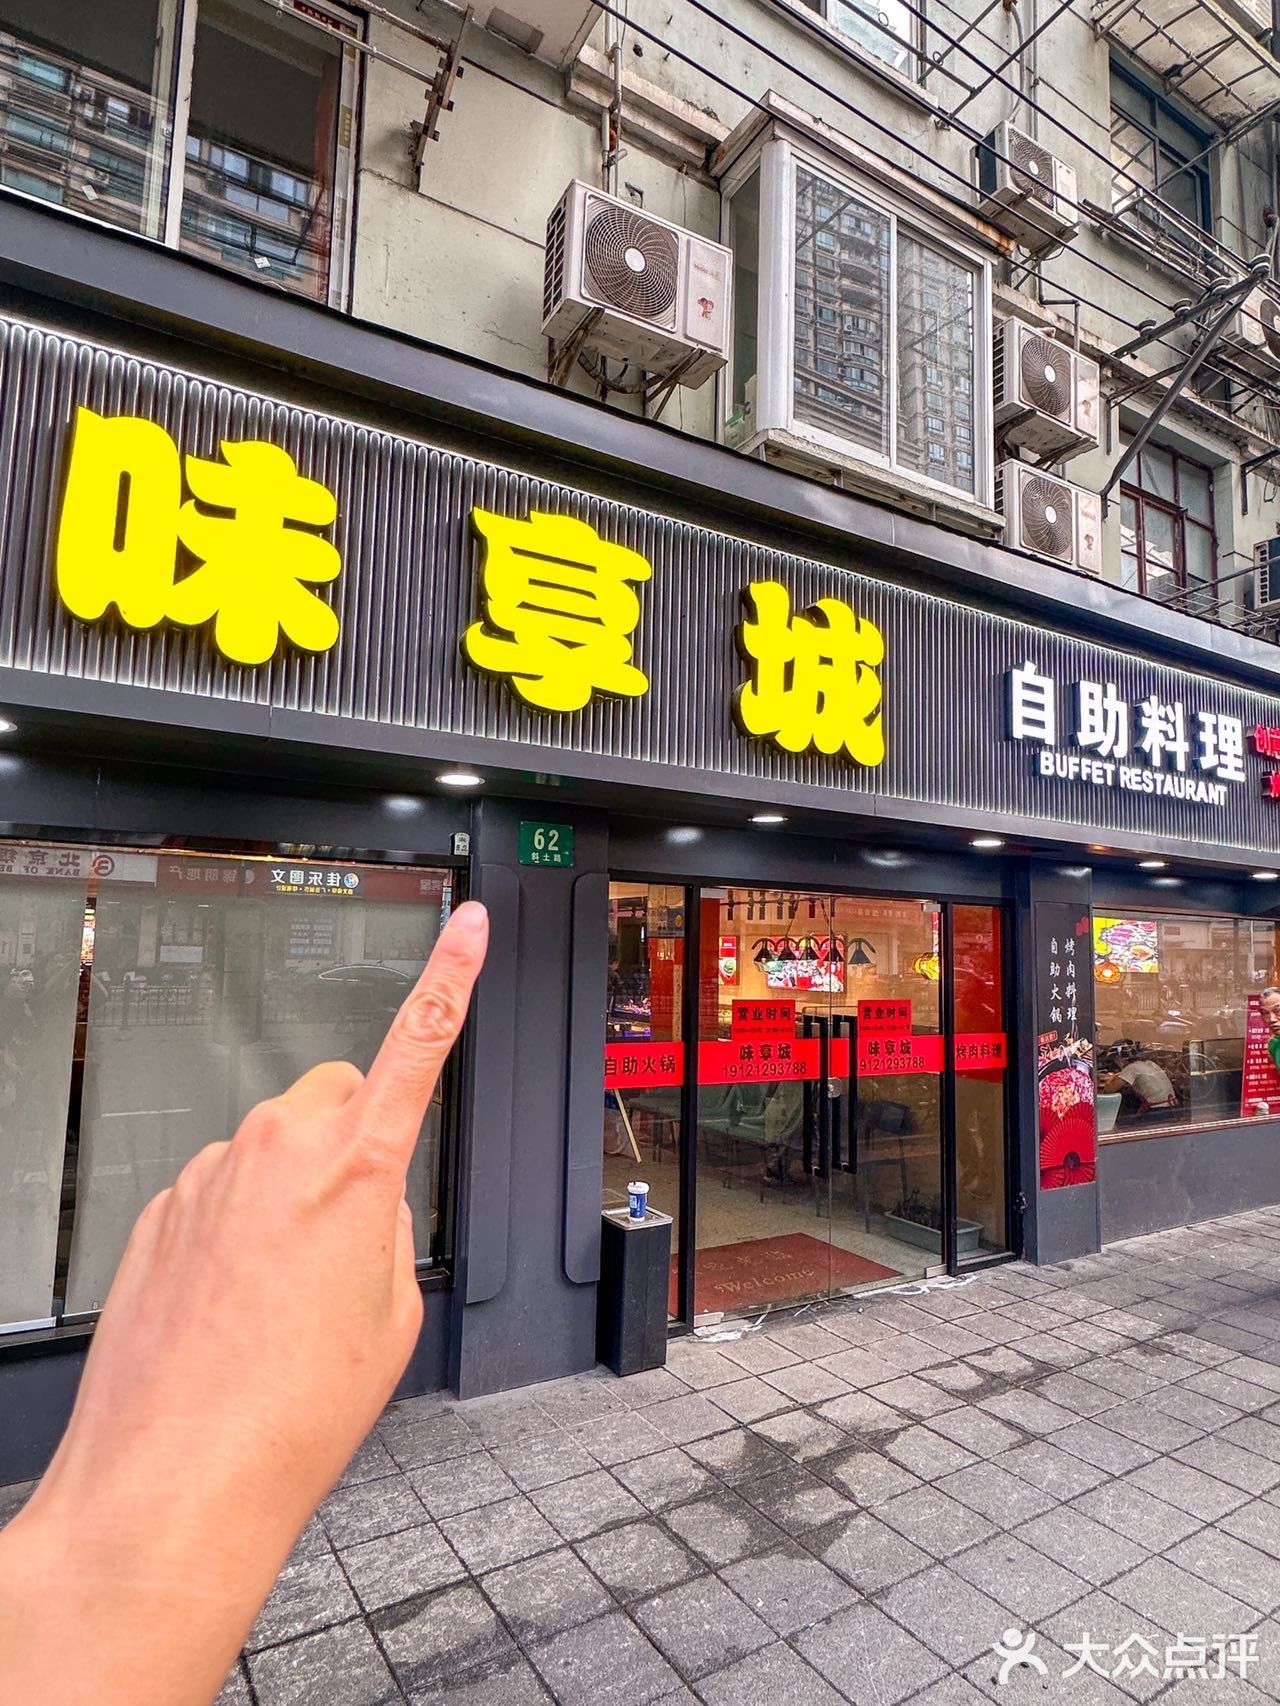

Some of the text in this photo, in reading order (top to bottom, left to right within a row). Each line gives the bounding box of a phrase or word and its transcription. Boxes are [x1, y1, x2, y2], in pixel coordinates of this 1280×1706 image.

[56, 407, 885, 767] 味享城
[1011, 660, 1246, 782] 自助料理
[1040, 751, 1115, 786] BUFFET
[1119, 765, 1228, 806] RESTAURANT
[534, 828, 559, 851] 62
[1065, 938, 1077, 1021] 烤肉料理
[738, 1006, 791, 1020] 营业时间
[863, 1006, 907, 1019] 营业时间
[740, 1043, 791, 1060] 味享城
[868, 1040, 911, 1056] 味享城
[956, 1043, 1002, 1059] 烤肉料理
[605, 1054, 676, 1076] 自助火锅
[723, 1061, 806, 1077] 19121293788
[714, 1267, 814, 1293] Welcome
